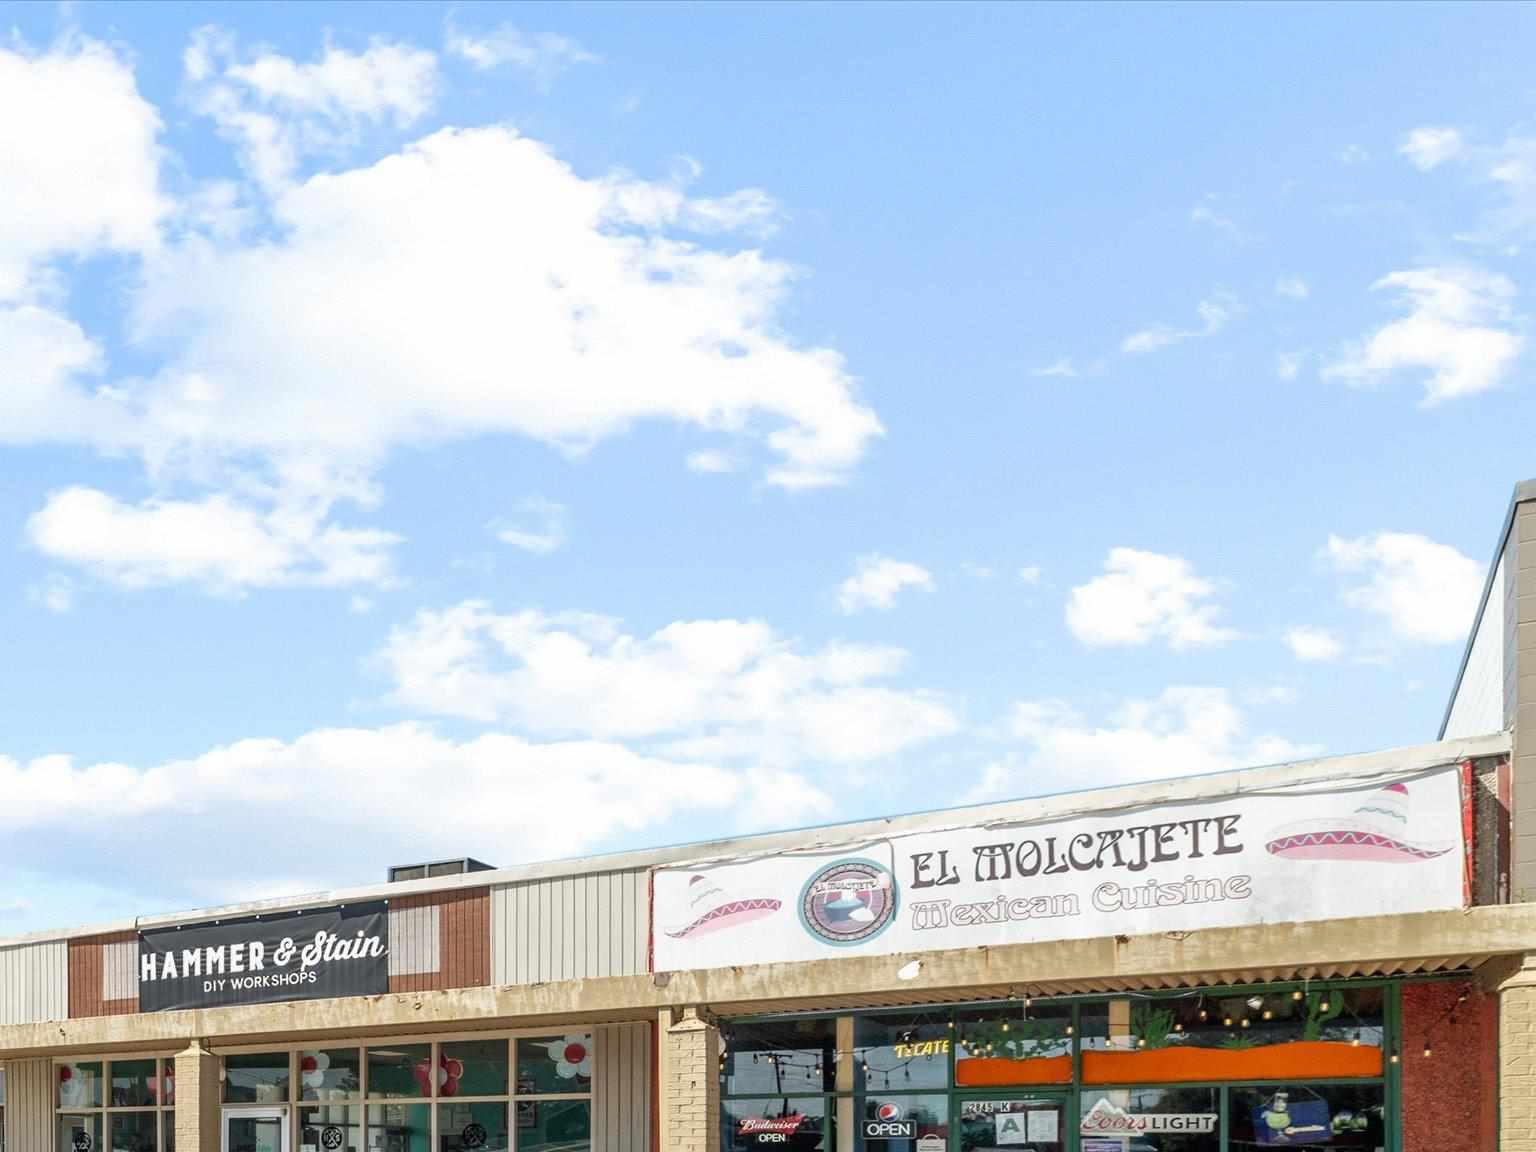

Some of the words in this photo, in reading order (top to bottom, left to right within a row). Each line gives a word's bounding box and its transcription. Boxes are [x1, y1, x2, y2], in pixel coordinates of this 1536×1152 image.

[910, 849, 960, 889] EL
[972, 814, 1244, 882] MOLCAJETE
[910, 894, 1081, 931] Mexican
[1092, 875, 1254, 912] Cuisine
[141, 941, 265, 982] HAMMER
[273, 937, 296, 966] &
[301, 929, 385, 972] Stain
[203, 979, 226, 993] DIY
[232, 971, 317, 989] WORKSHOPS
[1001, 1102, 1009, 1112] K
[740, 1119, 799, 1130] Budweiser
[866, 1122, 911, 1136] OPEN
[1001, 1118, 1021, 1132] A
[1082, 1110, 1148, 1131] Coors
[1151, 1116, 1214, 1130] LIGHT
[759, 1133, 786, 1143] OPEN
